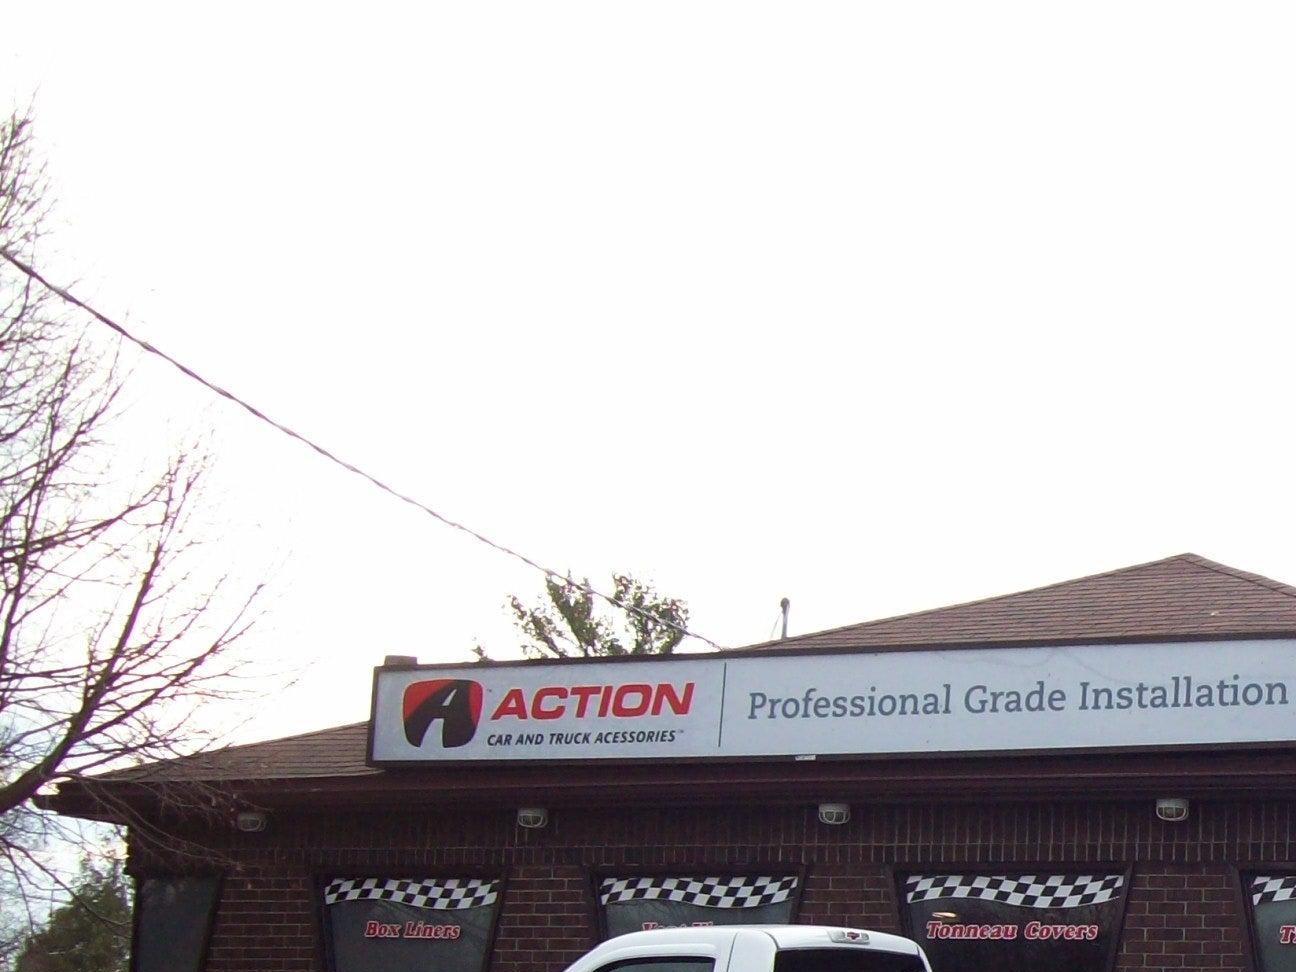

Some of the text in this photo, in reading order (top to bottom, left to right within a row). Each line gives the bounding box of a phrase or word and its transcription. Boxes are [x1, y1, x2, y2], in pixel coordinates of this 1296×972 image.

[490, 682, 695, 721] ACTION
[747, 674, 1290, 720] Professional Grade Installation
[487, 730, 677, 747] CAR AND TRUCK ACESSORIES
[365, 921, 461, 939] Box Liners
[927, 921, 1099, 940] Tonneau Covers
